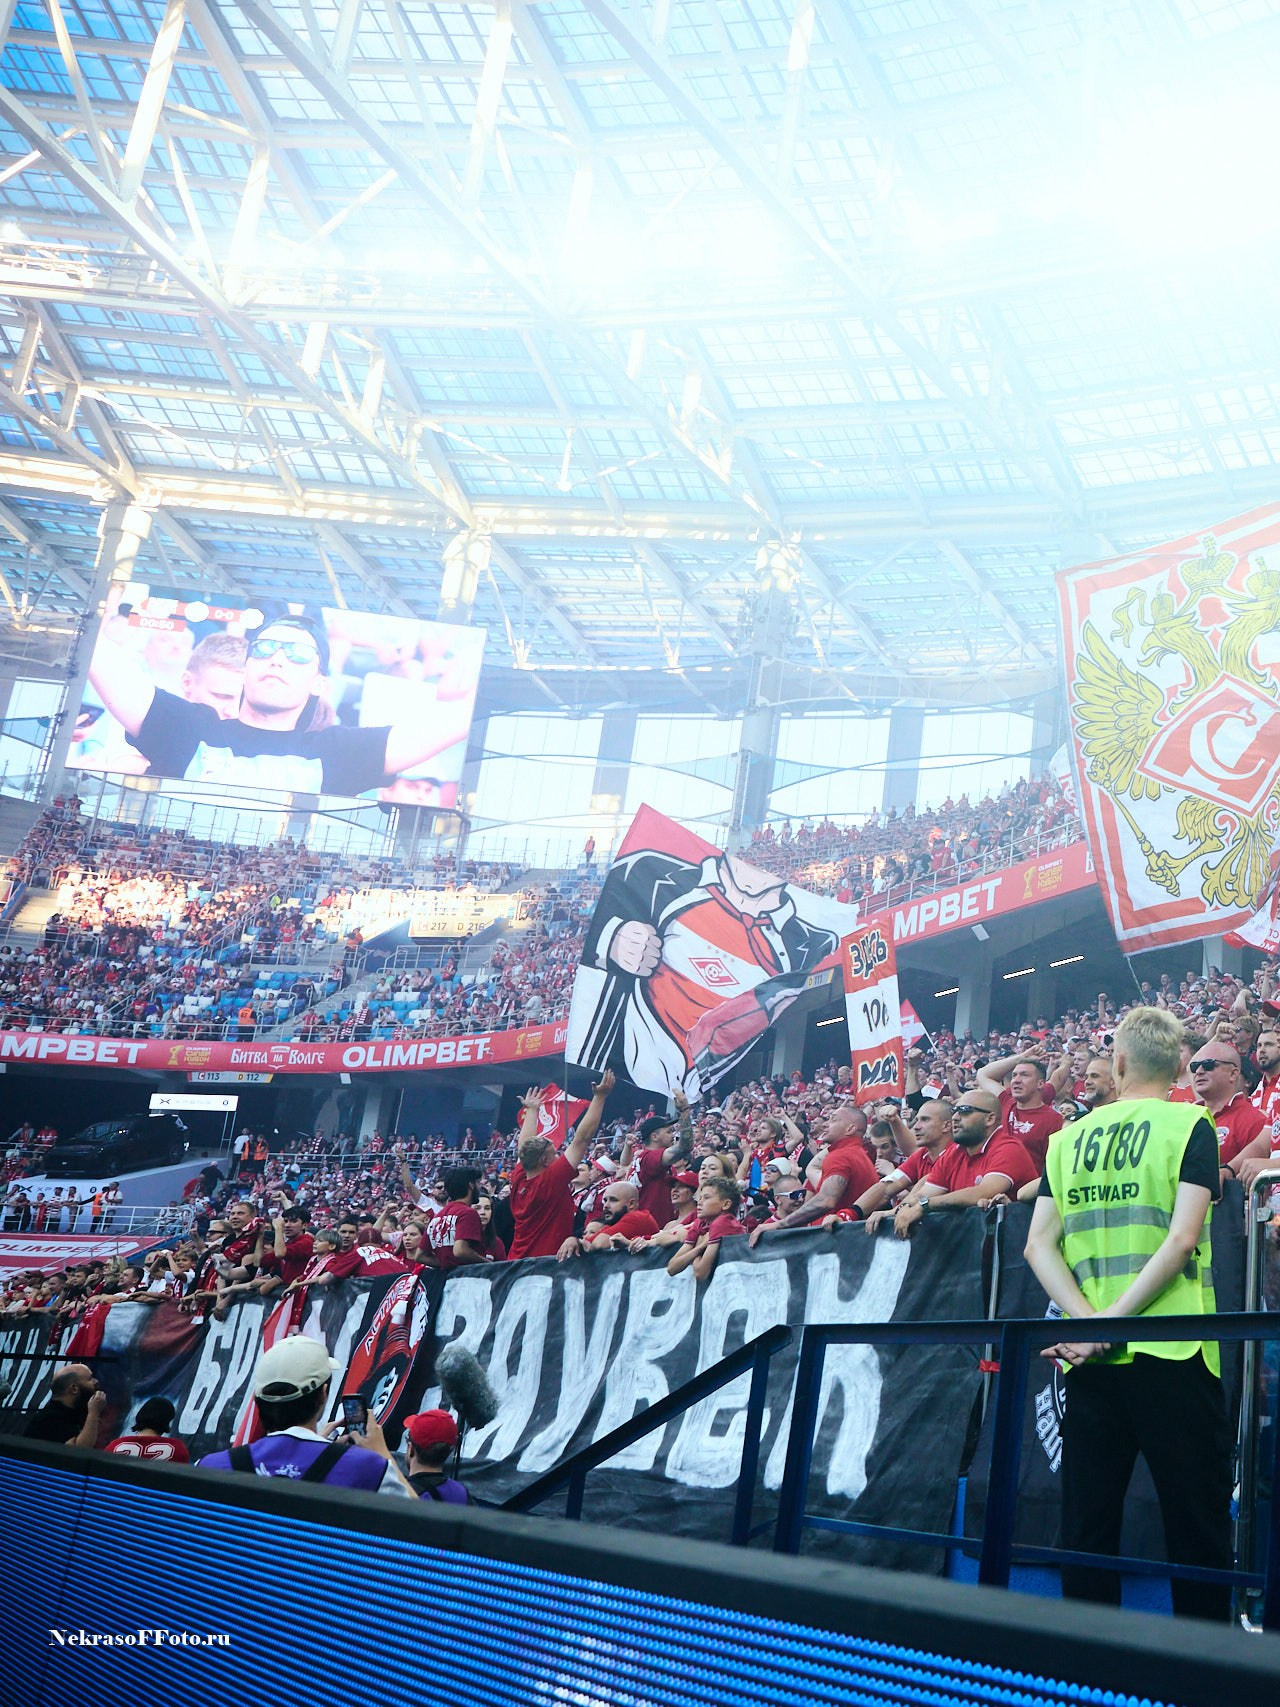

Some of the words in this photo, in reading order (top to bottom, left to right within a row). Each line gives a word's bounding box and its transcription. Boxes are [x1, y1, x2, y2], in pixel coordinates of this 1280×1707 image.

[893, 878, 1002, 940] MPBET
[0, 1035, 148, 1064] MPBET
[231, 1048, 268, 1065] БИТВА
[288, 1049, 325, 1066] ВОЛГЕ
[342, 1037, 491, 1068] OLIMPBET
[1072, 1120, 1151, 1174] 16780
[1067, 1182, 1140, 1206] STEWARD
